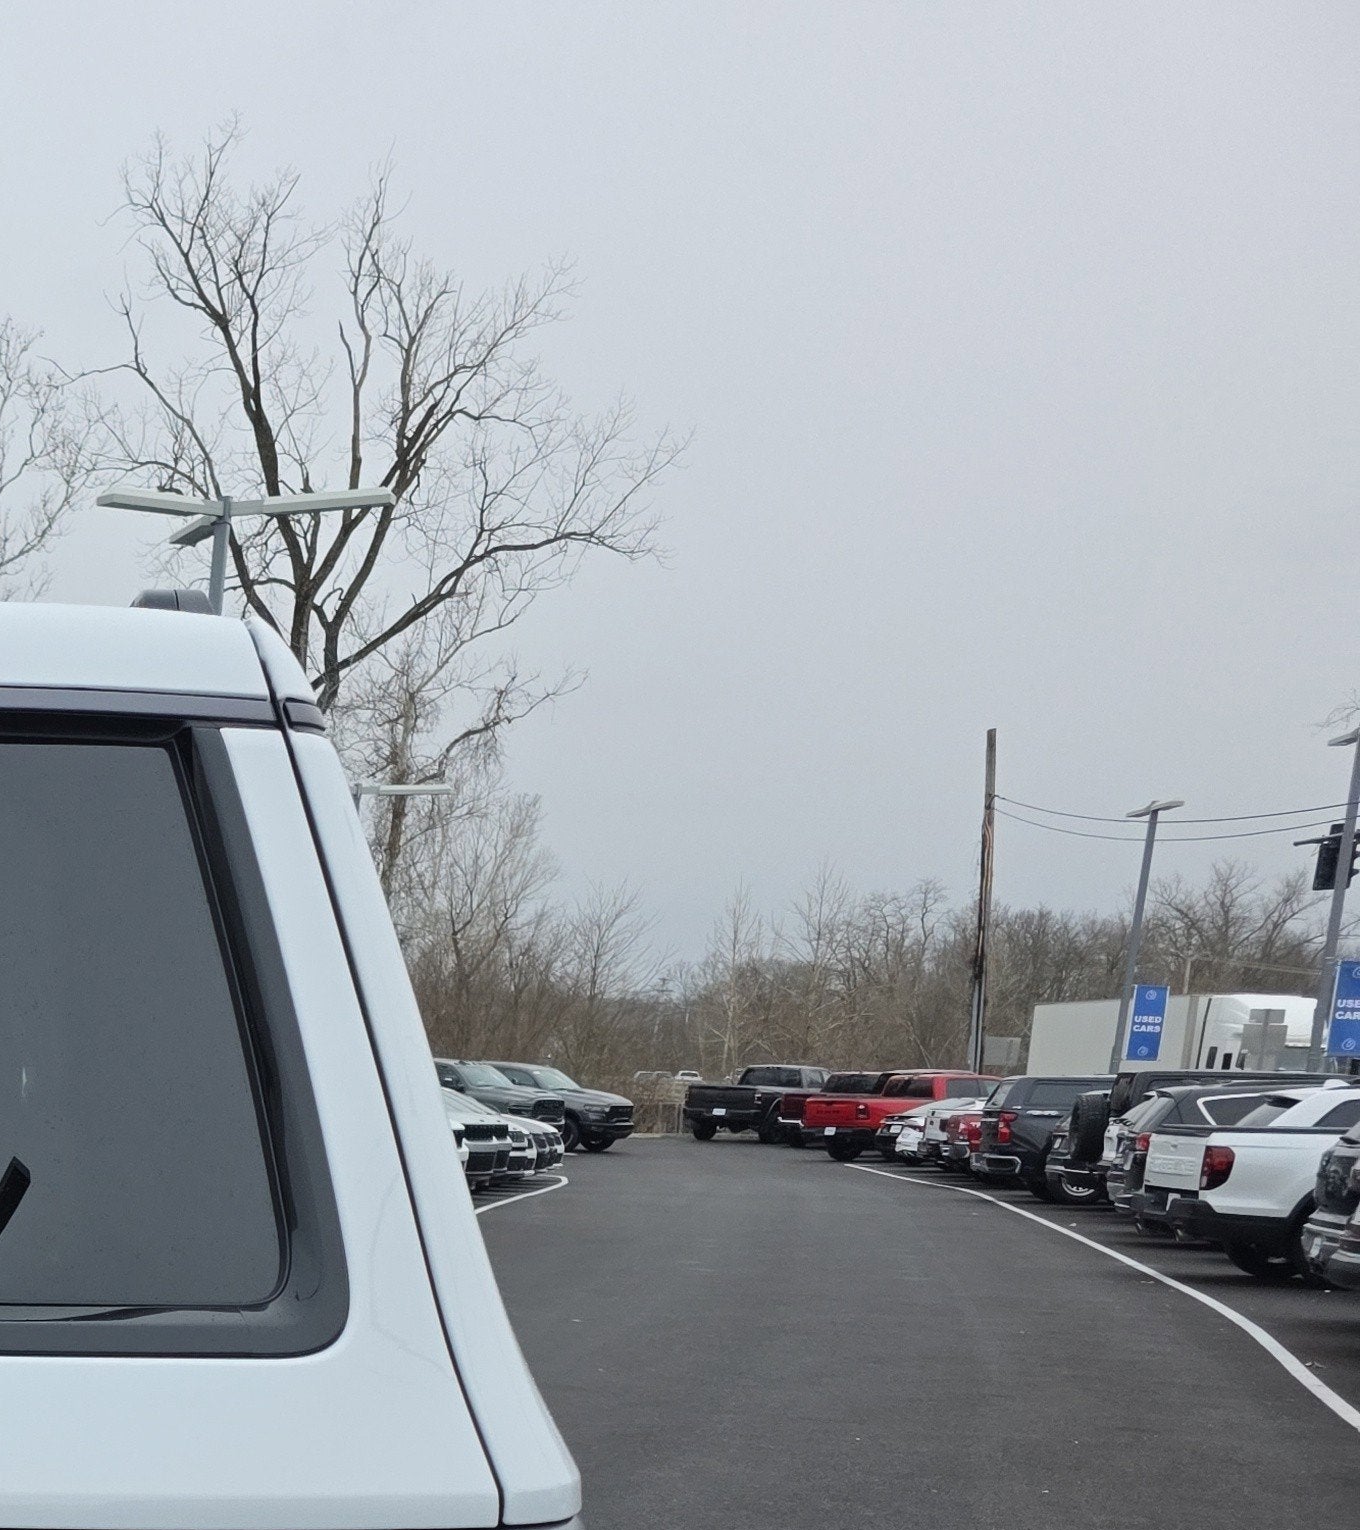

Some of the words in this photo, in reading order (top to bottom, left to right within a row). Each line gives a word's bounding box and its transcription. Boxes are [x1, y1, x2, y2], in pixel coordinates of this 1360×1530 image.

[1337, 999, 1360, 1008] USE
[1134, 1015, 1162, 1024] USED
[1335, 1011, 1360, 1020] CAR
[1133, 1024, 1161, 1033] CARS
